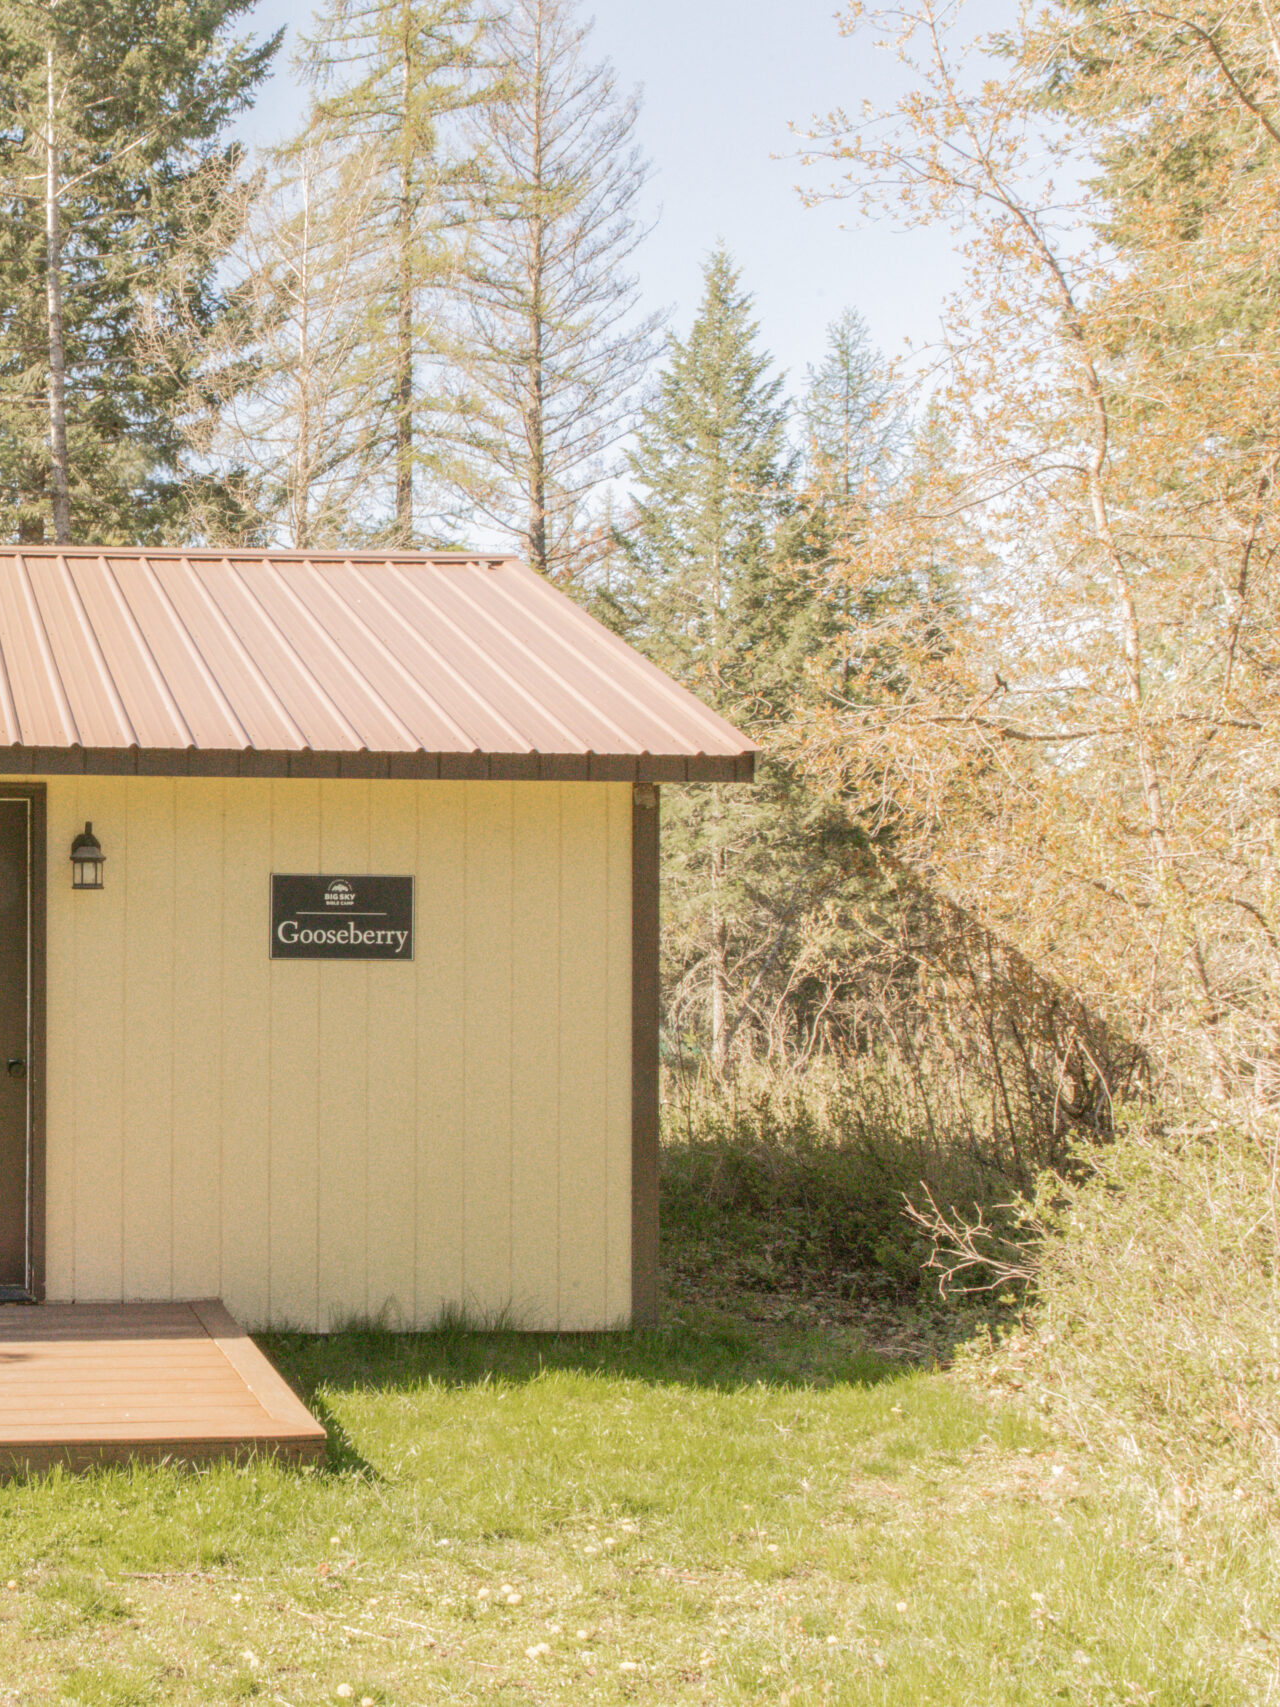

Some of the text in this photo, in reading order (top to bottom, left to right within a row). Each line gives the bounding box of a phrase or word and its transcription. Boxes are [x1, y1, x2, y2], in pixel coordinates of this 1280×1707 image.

[324, 893, 356, 901] BIG SKY
[277, 920, 408, 953] Gooseberry
